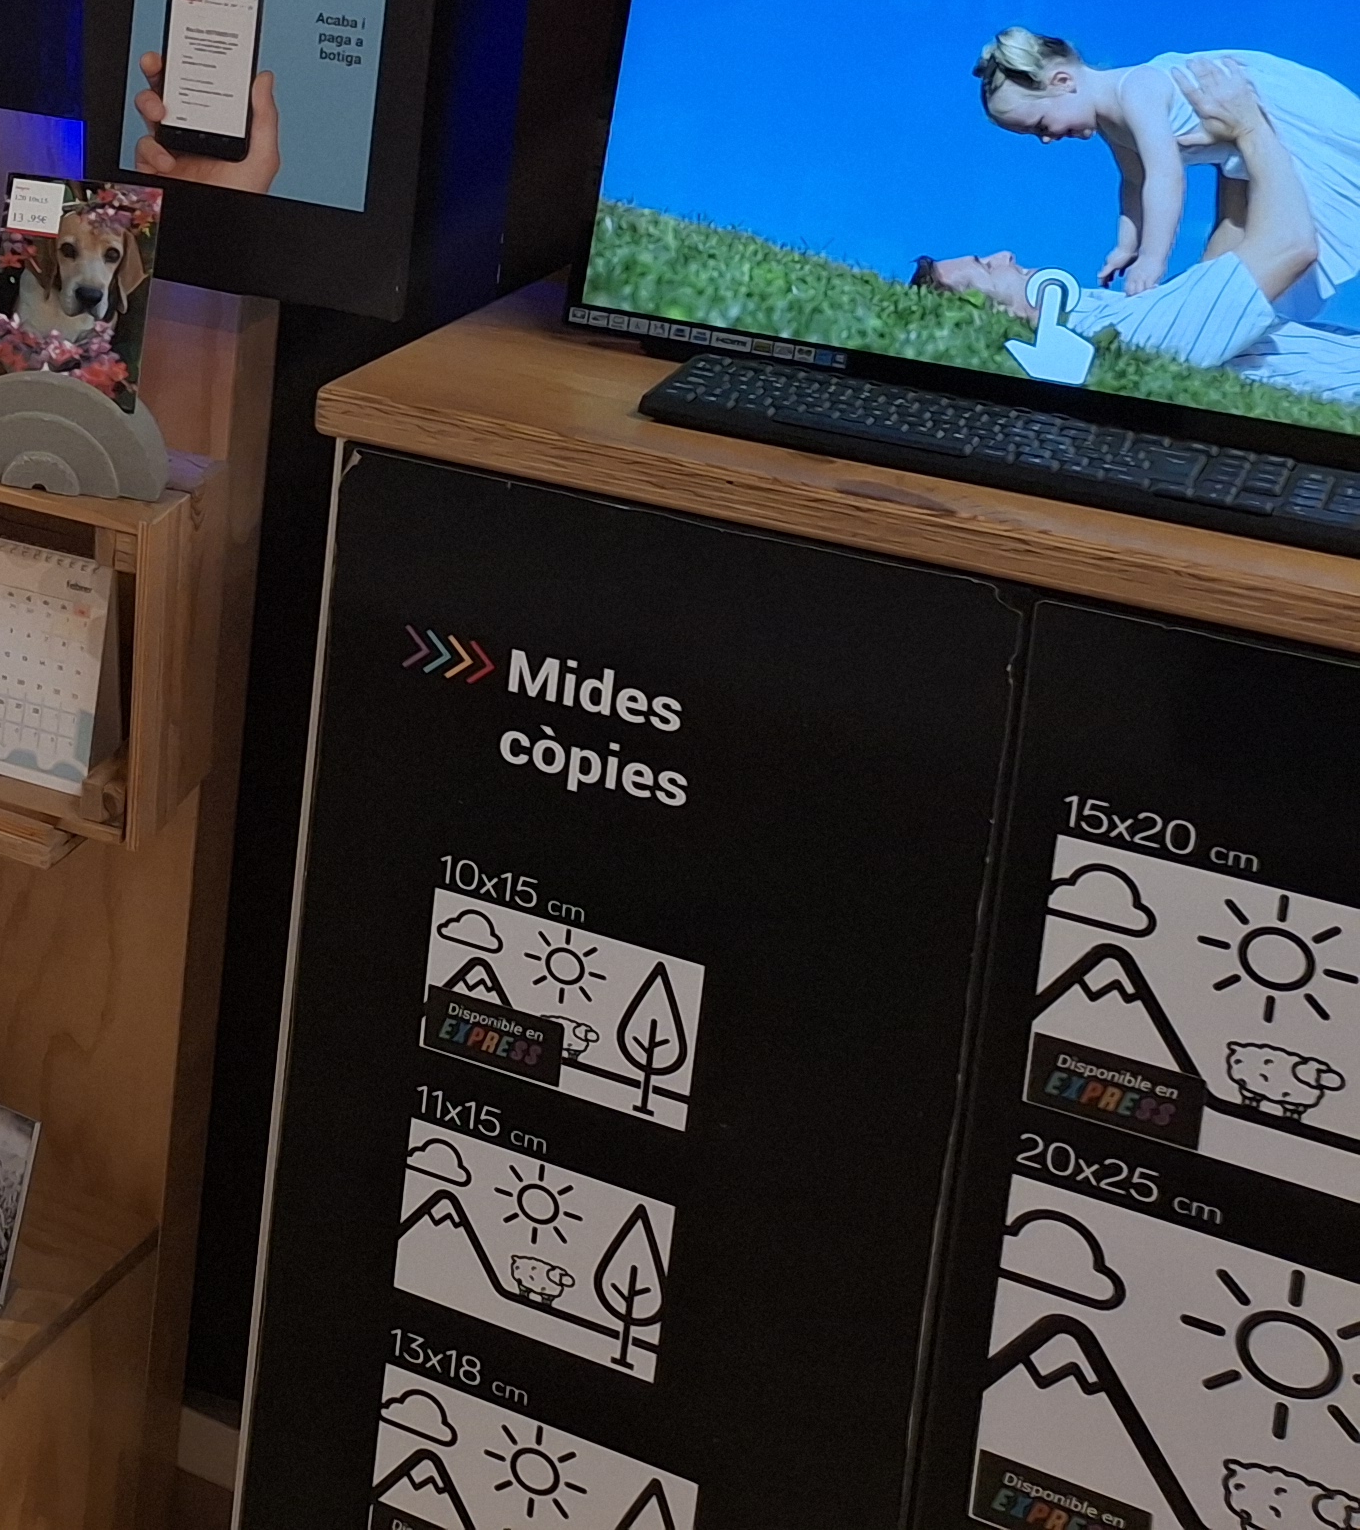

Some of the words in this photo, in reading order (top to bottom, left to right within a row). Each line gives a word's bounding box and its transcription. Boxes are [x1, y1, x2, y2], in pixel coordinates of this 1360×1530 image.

[315, 12, 358, 29] Acaba
[361, 17, 366, 30] i
[318, 33, 352, 47] paga
[355, 37, 364, 48] a
[319, 47, 362, 67] botiga
[507, 648, 683, 732] Mides
[499, 724, 689, 807] còpies
[1063, 794, 1198, 856] 15x20
[1209, 844, 1261, 873] cm
[440, 855, 540, 909] 10x15
[547, 900, 586, 923] cm
[438, 1017, 543, 1066] EXPRESS
[448, 1002, 523, 1037] Disponible
[526, 1028, 544, 1043] en
[1044, 1070, 1177, 1127] EXPRESS
[1056, 1054, 1152, 1092] Disponible
[1155, 1085, 1180, 1100] en
[416, 1085, 502, 1138] 11x15
[510, 1129, 548, 1155] cm
[1016, 1133, 1160, 1203] 20x25
[1172, 1195, 1224, 1225] cm
[390, 1327, 482, 1387] 13x18
[491, 1380, 529, 1407] cm
[990, 1487, 1118, 1530] EXPRE
[1002, 1472, 1099, 1519] Disponible
[1102, 1513, 1127, 1529] en
